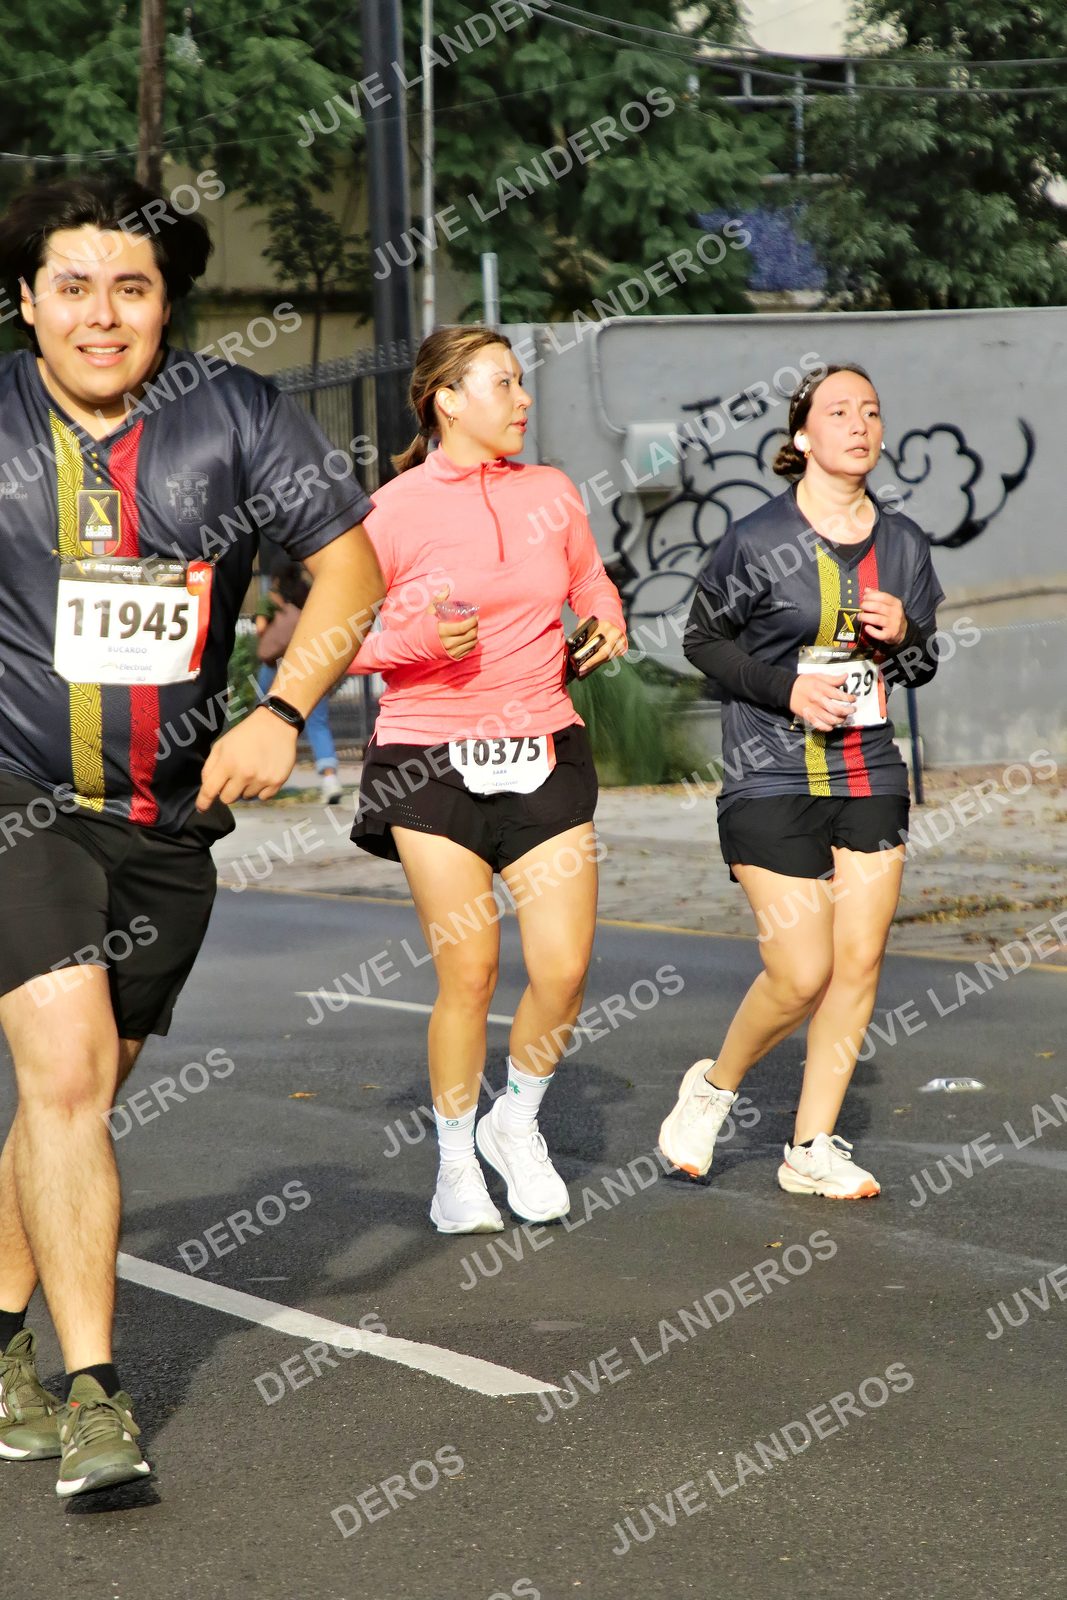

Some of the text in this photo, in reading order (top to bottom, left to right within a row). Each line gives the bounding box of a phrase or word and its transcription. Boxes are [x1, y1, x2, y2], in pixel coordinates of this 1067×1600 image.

[68, 598, 189, 641] 11945
[108, 646, 147, 654] BUCARDO
[455, 736, 541, 766] 10375
